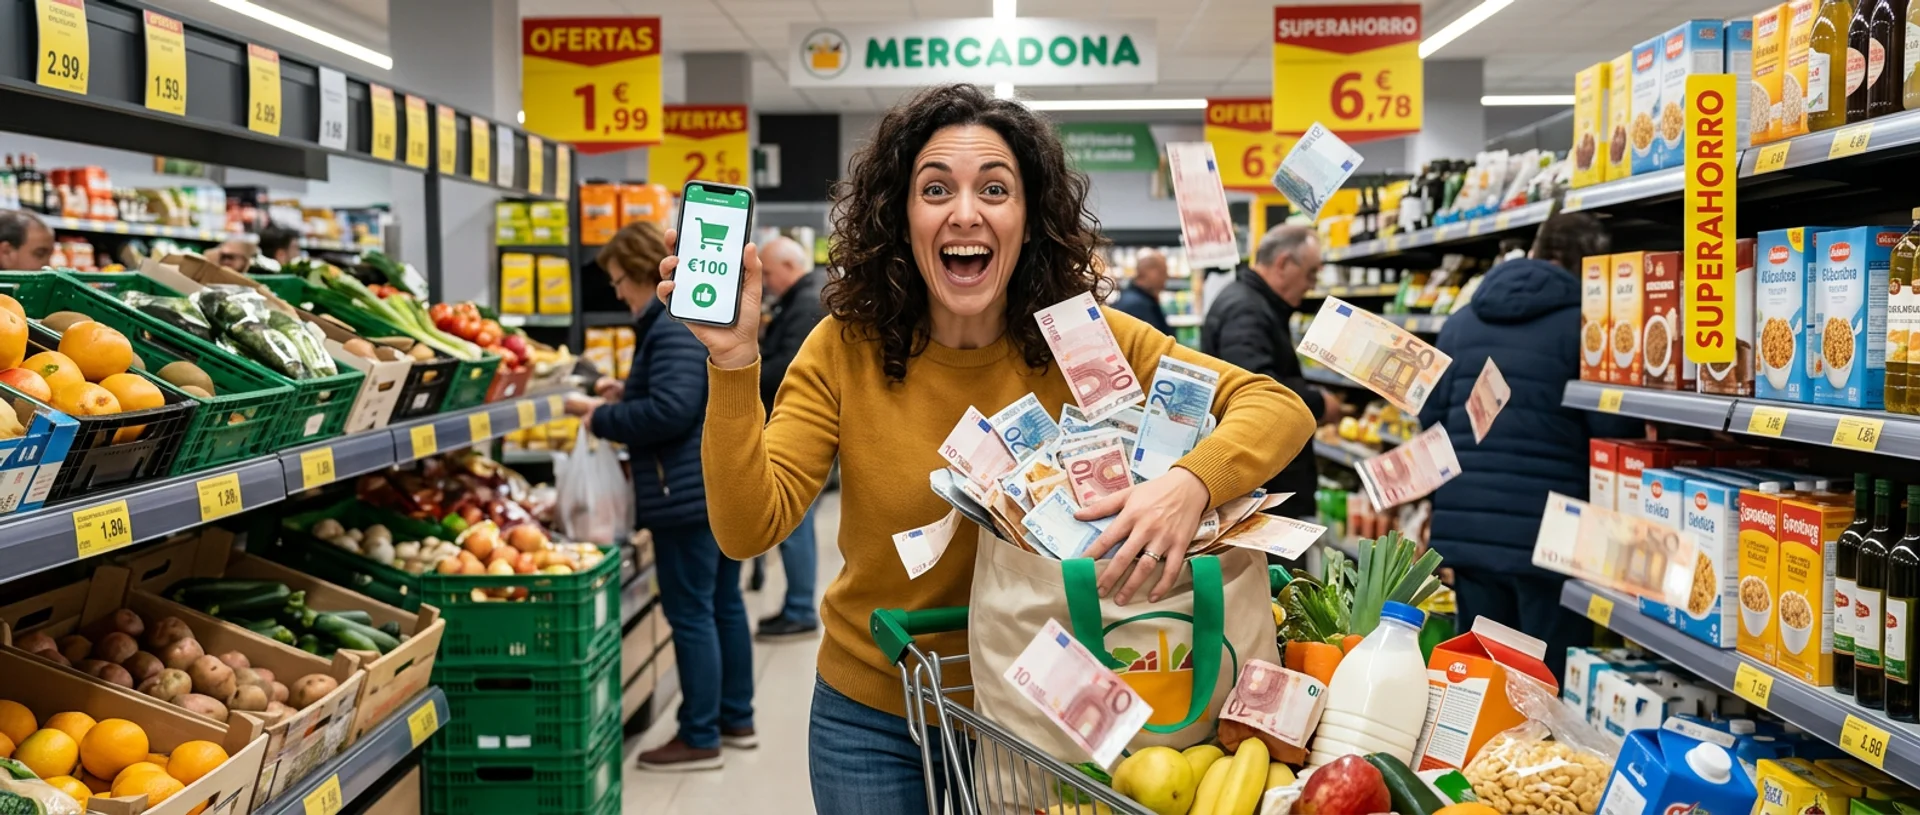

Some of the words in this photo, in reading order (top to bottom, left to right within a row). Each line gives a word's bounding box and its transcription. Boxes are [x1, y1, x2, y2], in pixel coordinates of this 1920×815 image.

[529, 26, 654, 51] OFERTAS
[1279, 17, 1417, 38] SUPERAHORRO
[865, 34, 1141, 69] MERCADONA
[47, 50, 80, 80] 2.99
[1696, 89, 1724, 348] SUPERAHORRO
[687, 257, 728, 276] €100
[1404, 339, 1435, 370] 50
[1107, 365, 1133, 390] 10
[944, 445, 958, 459] 10
[1071, 460, 1094, 486] 10
[1013, 666, 1031, 686] 10
[1103, 680, 1132, 714] 10
